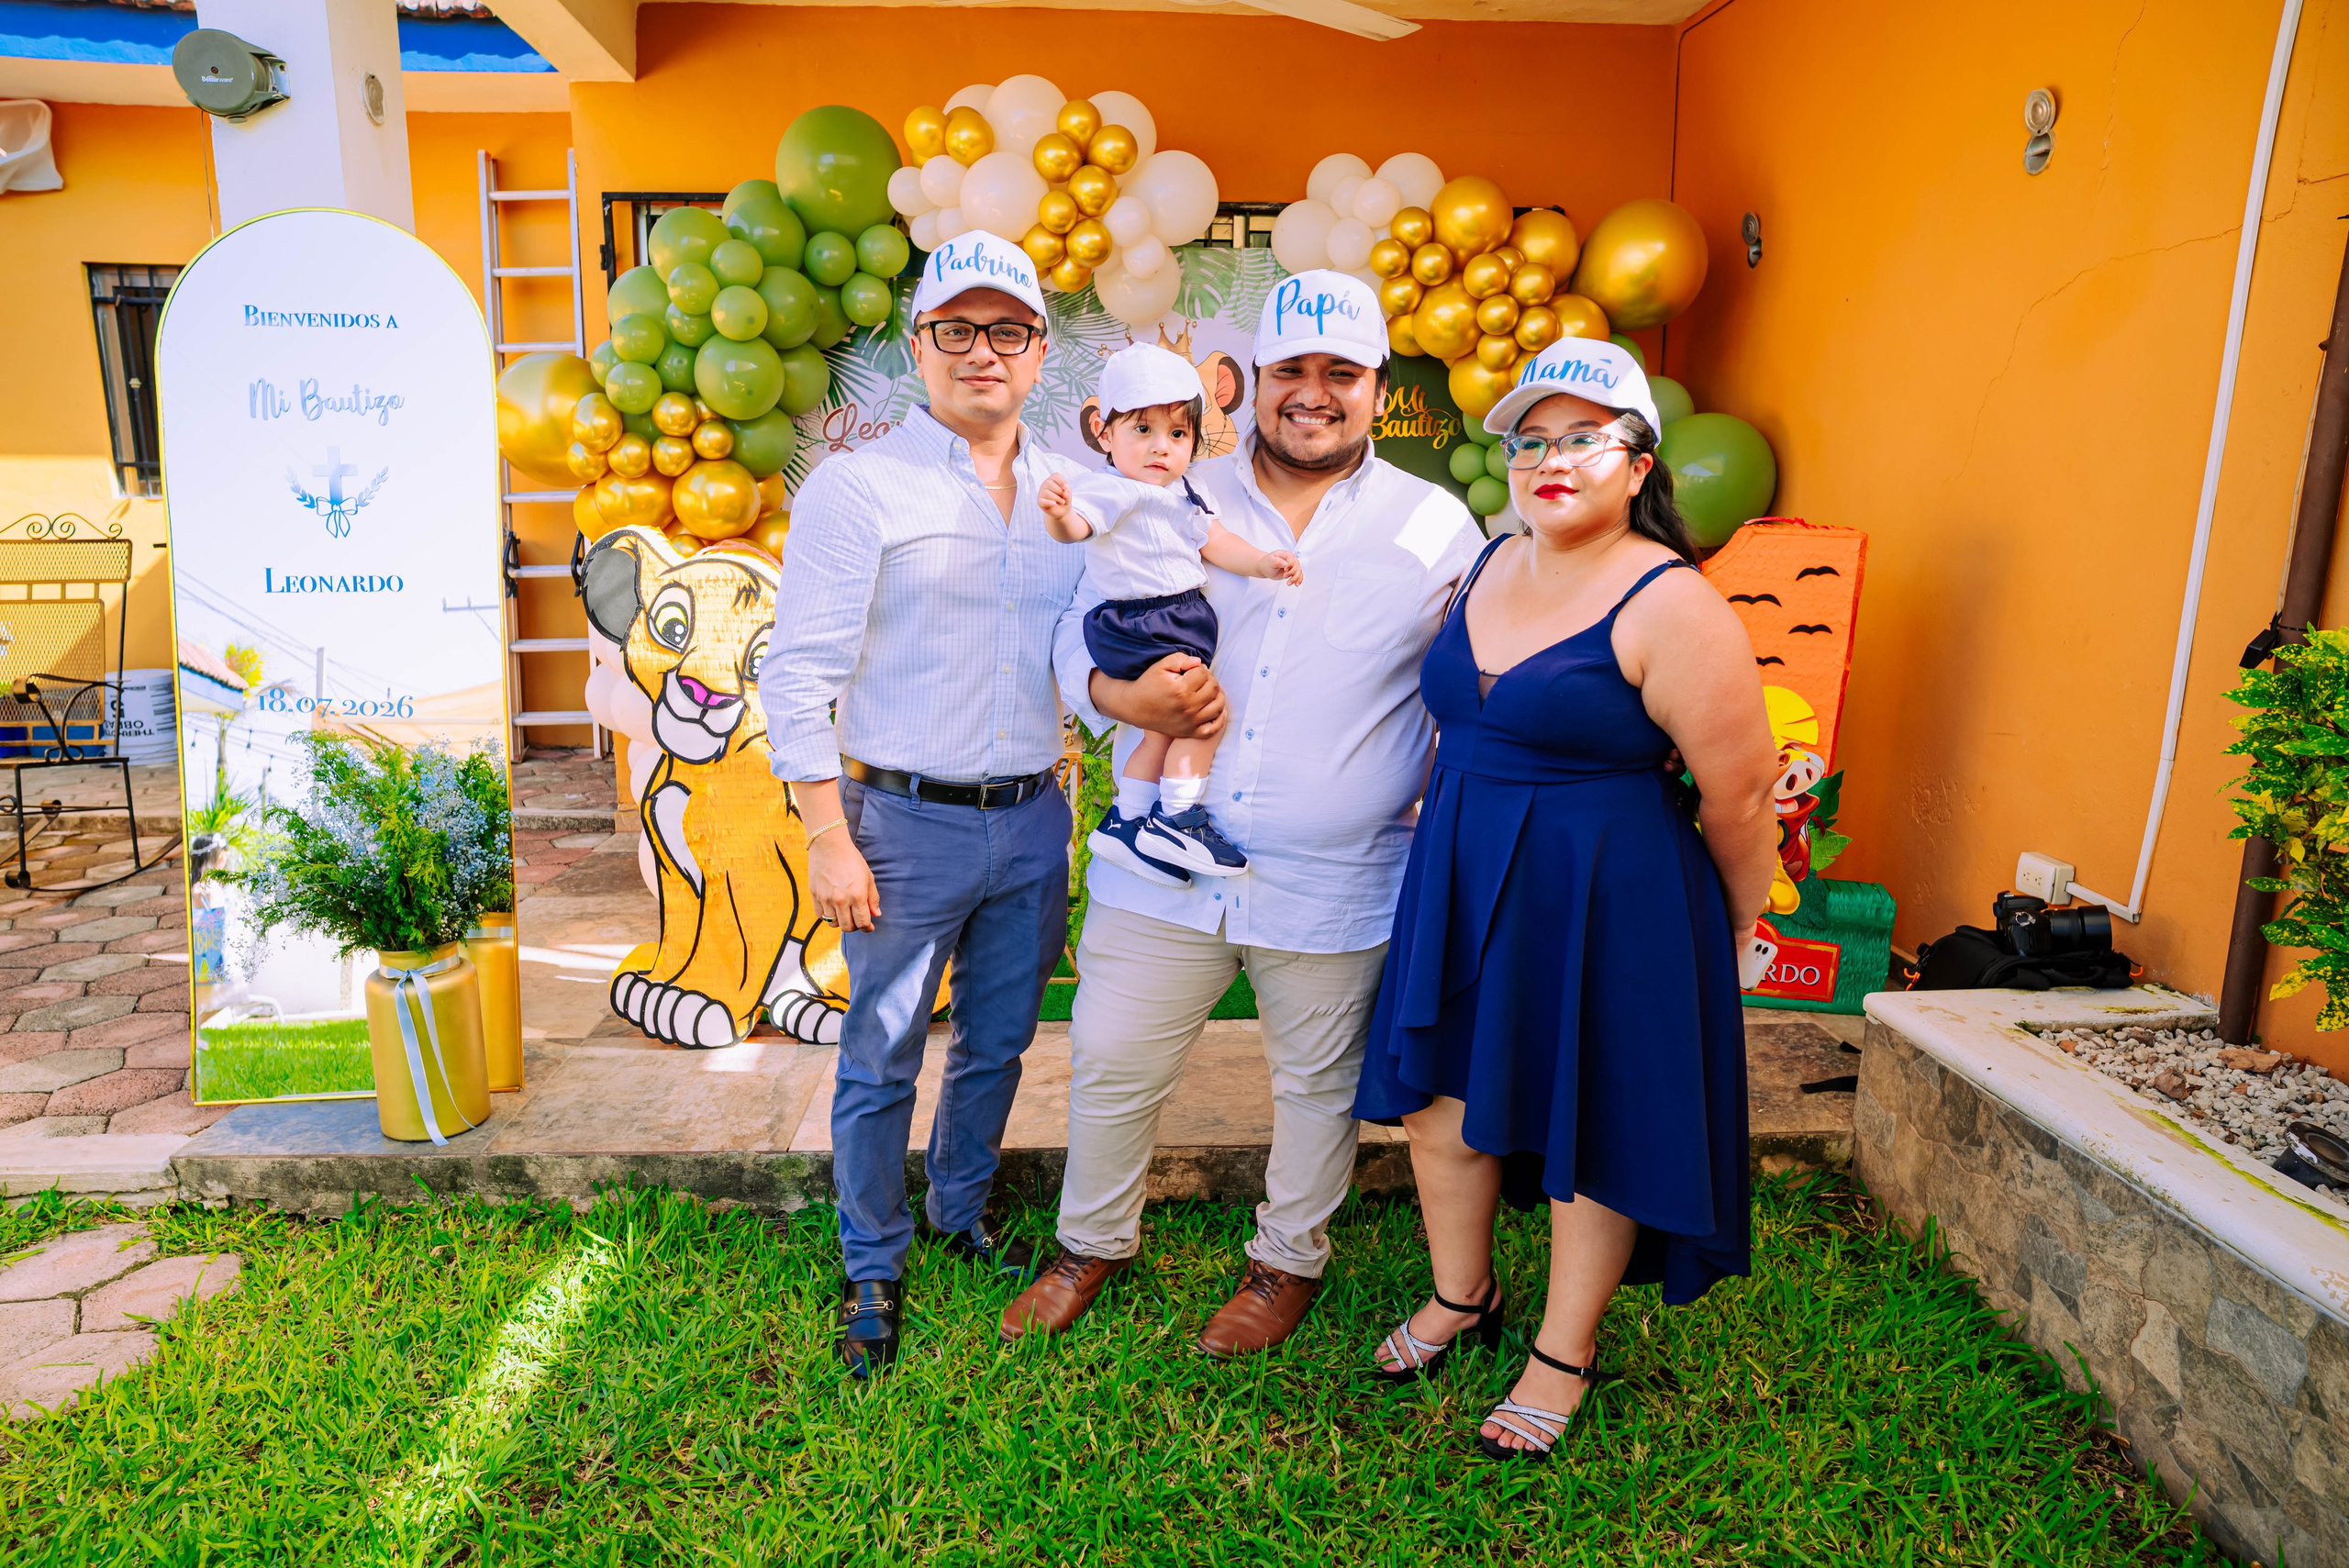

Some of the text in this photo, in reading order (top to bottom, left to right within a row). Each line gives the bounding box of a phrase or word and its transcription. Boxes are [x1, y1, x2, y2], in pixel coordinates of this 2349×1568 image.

[935, 242, 1033, 288] Padrino
[243, 305, 399, 328] BIENVENIDOS A
[1275, 278, 1361, 336] Papá
[249, 377, 406, 427] Mi Bautizo
[1385, 384, 1428, 417] Mi
[822, 402, 903, 452] Leo
[1370, 410, 1463, 450] Bautizo
[263, 567, 404, 594] LEONARDO
[258, 687, 414, 718] 18.07.2026
